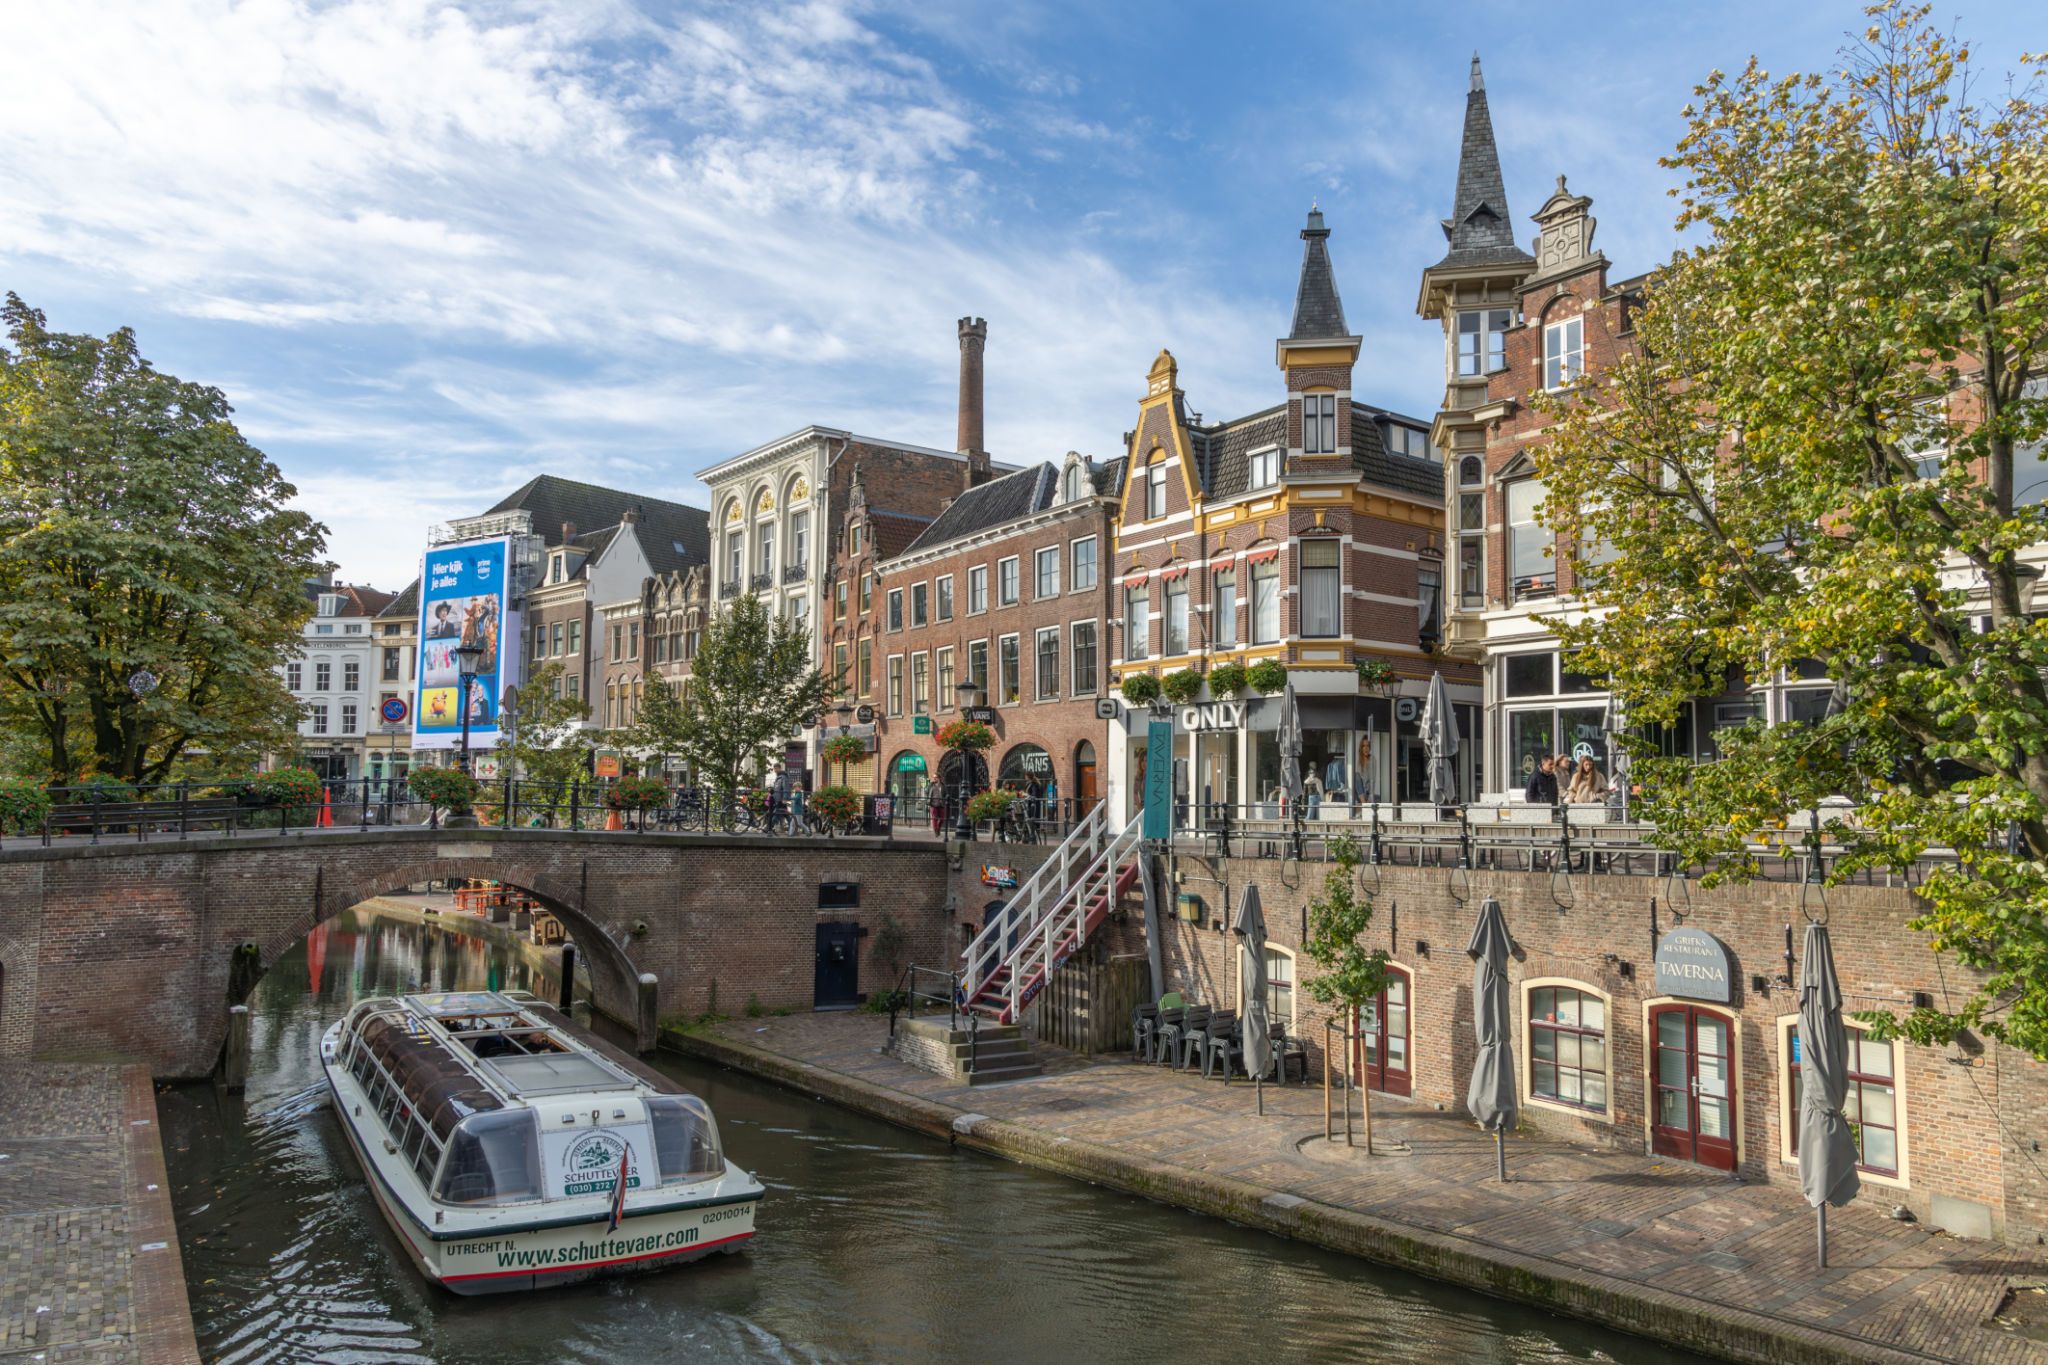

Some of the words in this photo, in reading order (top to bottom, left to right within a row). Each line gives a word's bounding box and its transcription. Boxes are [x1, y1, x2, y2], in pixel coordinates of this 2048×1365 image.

[432, 563, 448, 575] Hier
[449, 560, 463, 575] kijk
[431, 577, 439, 591] je
[439, 575, 457, 588] alles
[972, 711, 991, 720] VANS
[1182, 702, 1246, 731] ONLY
[1021, 752, 1049, 773] VANS
[1152, 731, 1166, 808] TAVERNA
[1664, 944, 1718, 956] RESTAURANT
[1675, 937, 1706, 946] GRIEKS
[1659, 961, 1724, 982] TAVERNA
[564, 1166, 638, 1183] SCHUTTEVER
[569, 1183, 592, 1194] (030)
[595, 1181, 610, 1190] 272
[703, 1206, 750, 1224] 02010014
[447, 1241, 500, 1256] UTRECHT
[504, 1239, 517, 1252] N.
[497, 1226, 699, 1268] www.schuttevaer.com
